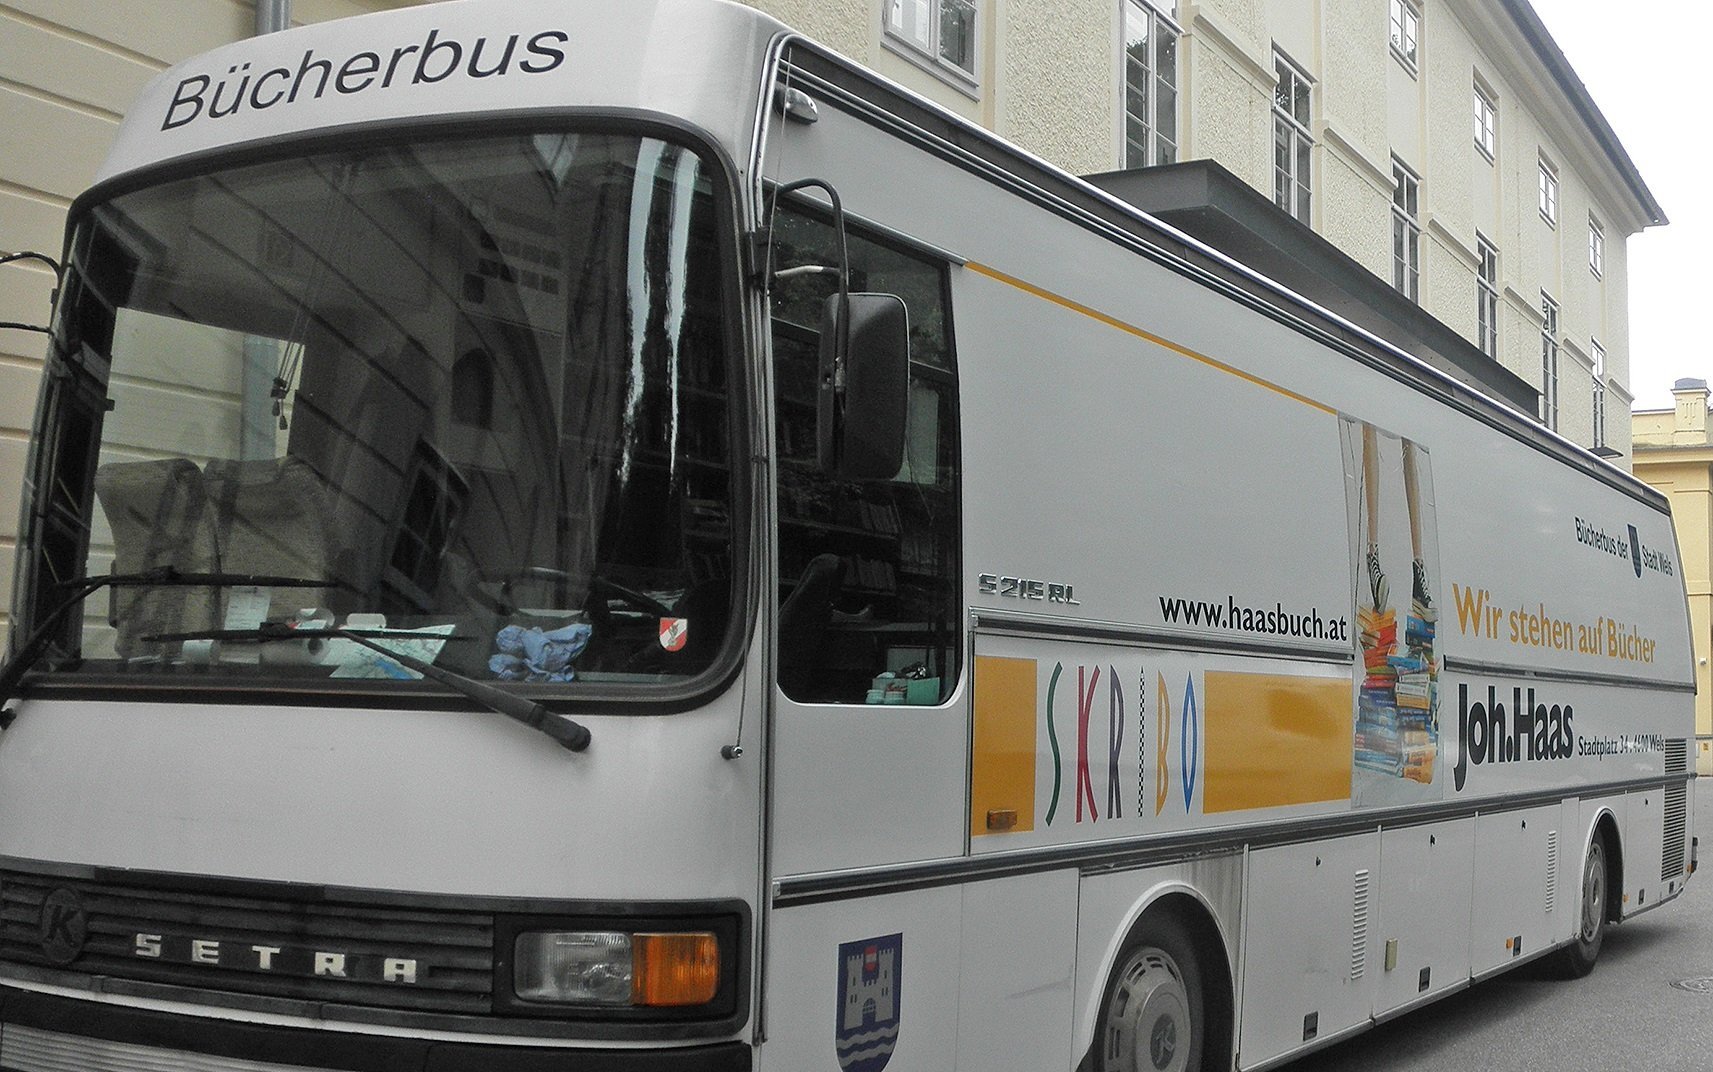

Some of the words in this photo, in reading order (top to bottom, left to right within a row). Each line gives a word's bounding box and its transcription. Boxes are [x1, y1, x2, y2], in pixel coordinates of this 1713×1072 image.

[161, 29, 569, 131] Bücherbus
[1575, 516, 1617, 556] Bücherbus
[1617, 535, 1629, 560] der
[1642, 544, 1659, 572] Stadt
[1657, 551, 1673, 577] Wels
[1048, 581, 1081, 605] RL
[1159, 595, 1347, 641] www.haasbuch.at
[1452, 583, 1502, 639] Wir
[1509, 603, 1574, 651] stehen
[1578, 616, 1603, 655] auf
[1607, 618, 1656, 663] Bücher
[1045, 661, 1198, 827] SKRIBO
[1578, 735, 1618, 761] Stadtplatz
[1649, 734, 1665, 752] Wels
[136, 933, 417, 984] SETRA
